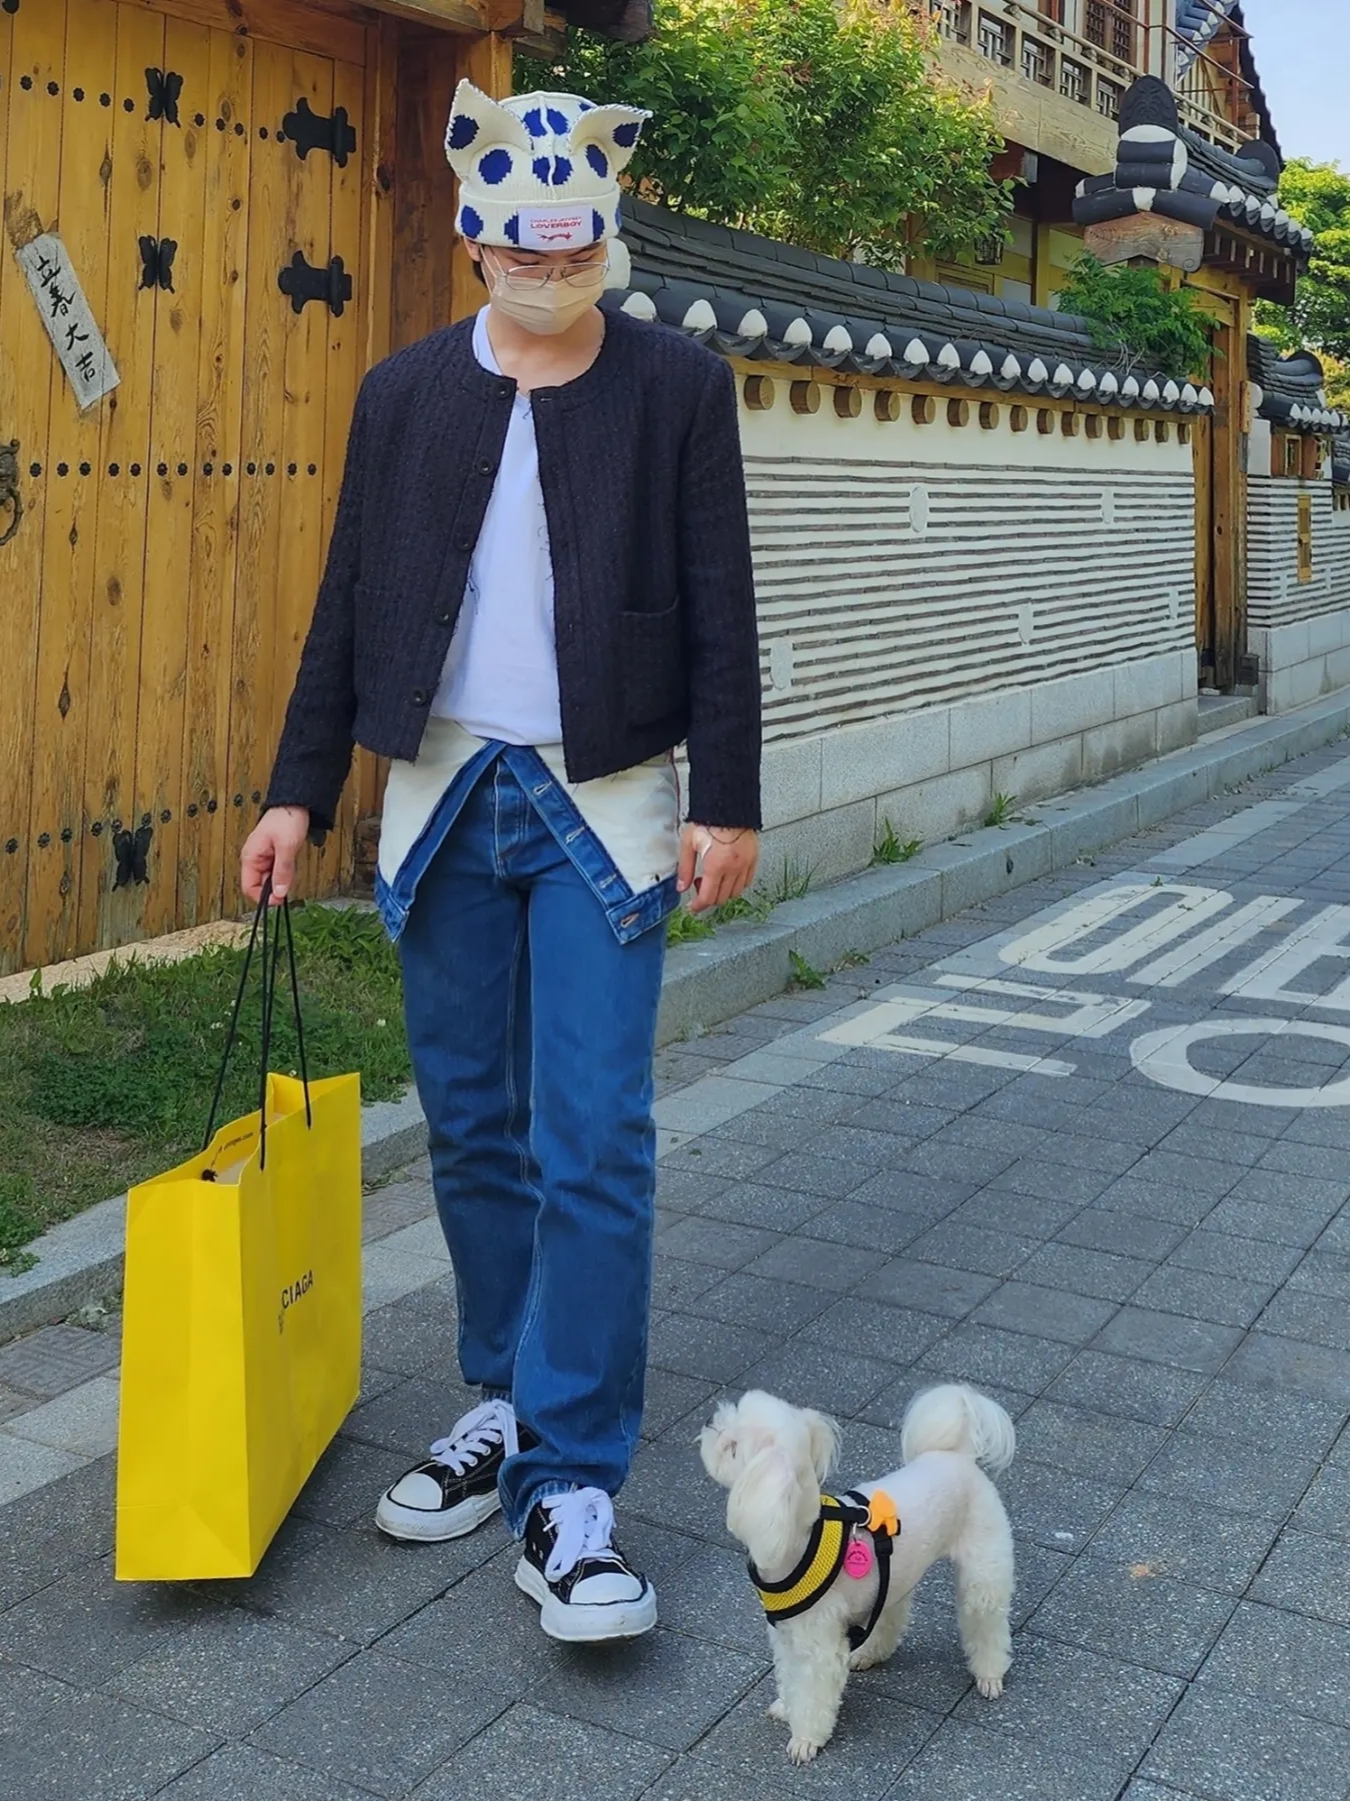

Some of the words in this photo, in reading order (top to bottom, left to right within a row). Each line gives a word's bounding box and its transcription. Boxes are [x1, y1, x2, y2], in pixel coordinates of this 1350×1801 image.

[530, 220, 582, 229] LOVERBOY
[37, 255, 95, 382] 立春大吉
